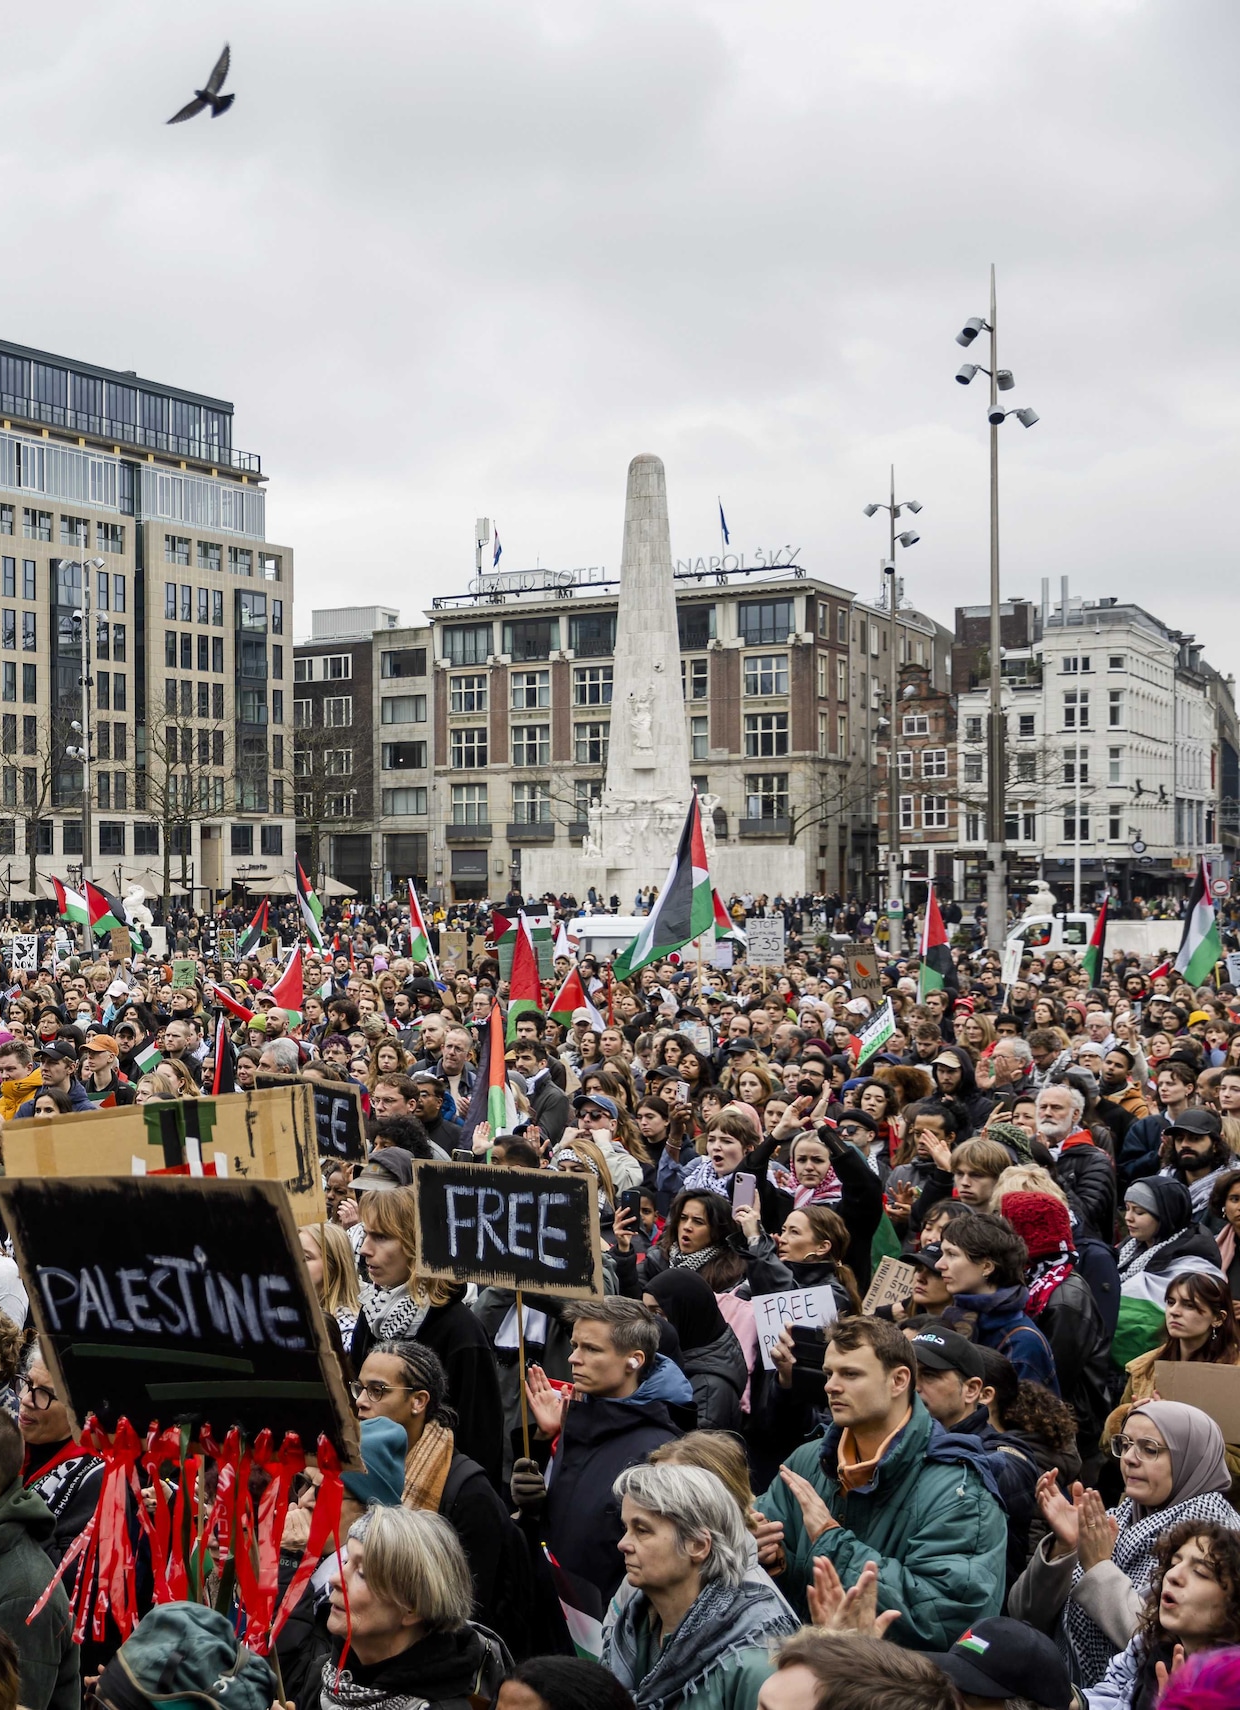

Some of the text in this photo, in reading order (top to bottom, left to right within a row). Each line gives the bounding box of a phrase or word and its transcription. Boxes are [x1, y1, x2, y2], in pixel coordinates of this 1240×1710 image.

[468, 546, 801, 594] GRAND HOTEL NAPOLSKY
[750, 920, 778, 930] STOP
[260, 947, 273, 956] STO
[747, 936, 782, 951] F-35
[14, 961, 35, 969] NOW
[315, 1094, 350, 1153] EE
[443, 1184, 571, 1270] FREE
[890, 1279, 913, 1297] STAR
[884, 1290, 899, 1303] ON
[763, 1293, 818, 1325] FREE
